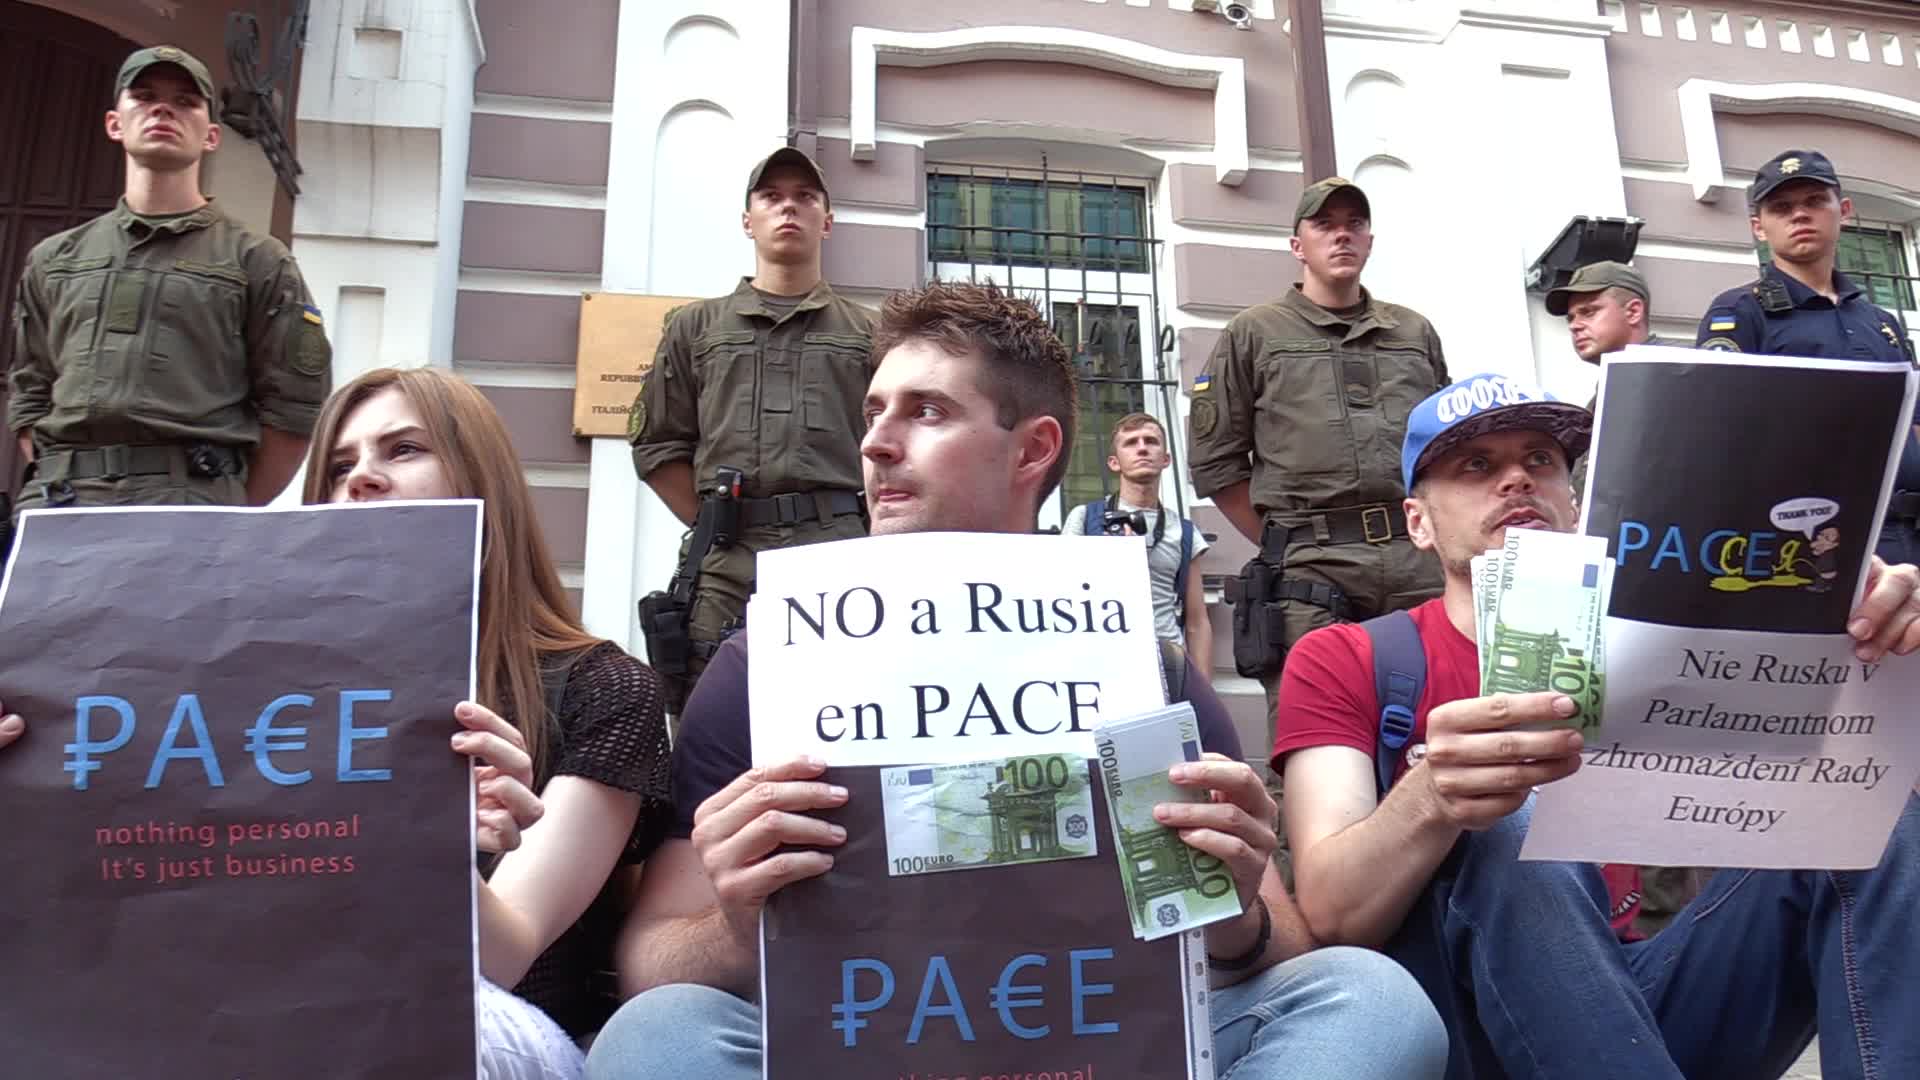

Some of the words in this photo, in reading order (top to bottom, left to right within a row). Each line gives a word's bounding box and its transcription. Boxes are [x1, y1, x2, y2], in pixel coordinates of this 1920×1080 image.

[782, 585, 885, 646] NO
[910, 598, 942, 635] a
[963, 581, 1131, 635] Rusia
[1677, 647, 1740, 682] Nie
[1751, 653, 1849, 685] Rusku
[1859, 661, 1880, 683] v
[815, 700, 889, 743] en
[910, 680, 1101, 739] PACE
[1640, 698, 1875, 736] Parlamentnom
[1098, 738, 1118, 769] 100
[1585, 742, 1808, 784] zhromaždení
[1809, 757, 1891, 791] Rady
[1005, 756, 1069, 790] 100
[95, 820, 216, 847] nothing
[228, 814, 361, 845] personal
[1664, 795, 1788, 834] Európy
[101, 858, 147, 881] It's
[155, 855, 215, 883] just
[226, 852, 356, 876] business
[894, 855, 925, 874] 100
